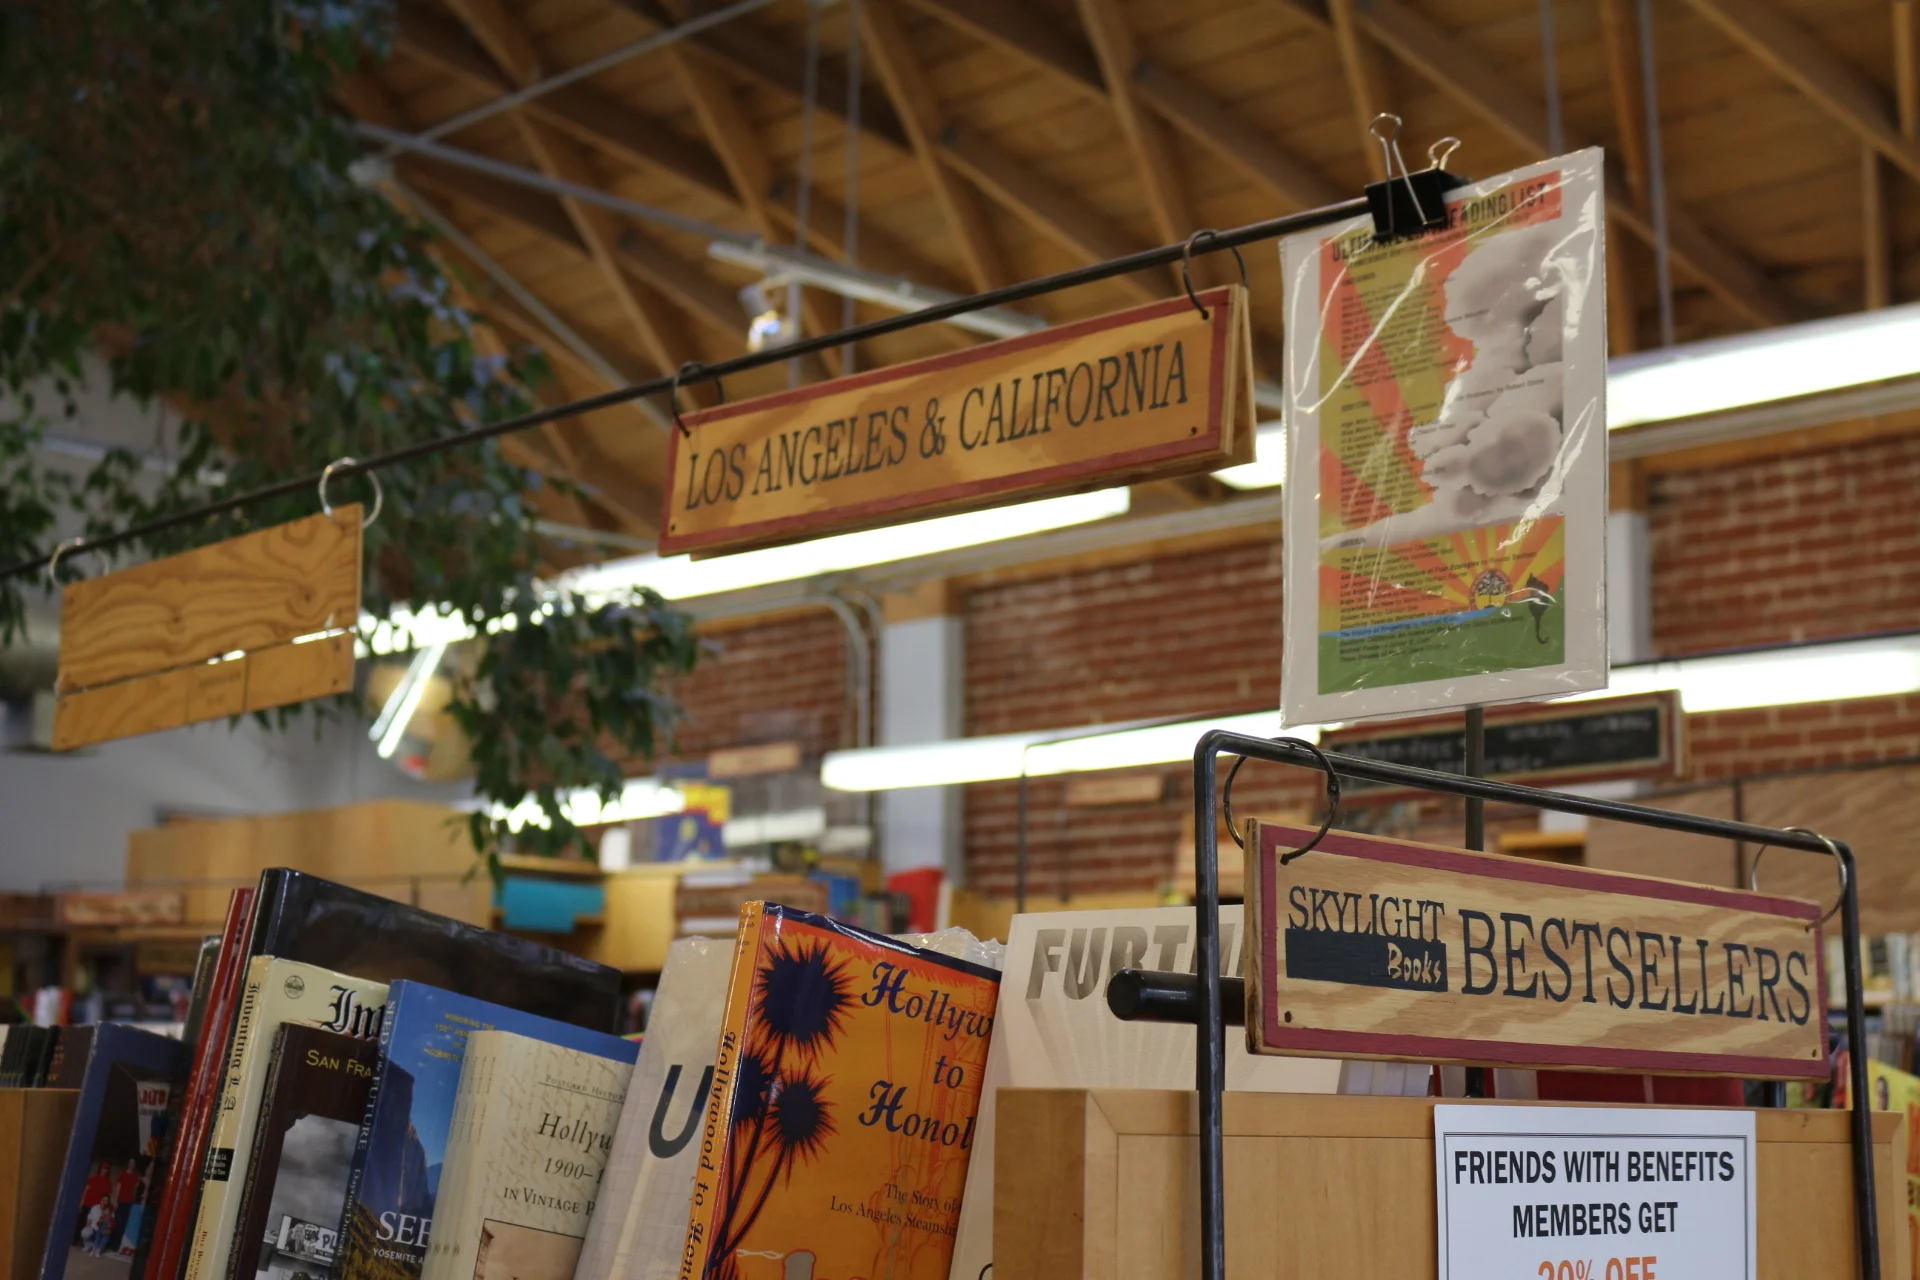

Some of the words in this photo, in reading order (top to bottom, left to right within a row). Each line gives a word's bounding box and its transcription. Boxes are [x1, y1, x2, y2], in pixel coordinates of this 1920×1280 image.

[686, 442, 746, 510] LOS
[751, 404, 908, 496] ANGELES
[919, 397, 946, 460] &
[958, 340, 1189, 452] CALIFORNIA
[1288, 885, 1445, 944] SKYLIGHT
[1458, 908, 1811, 1026] BESTSELLERS
[1386, 942, 1442, 985] Books
[379, 999, 396, 1046] SEED
[306, 1049, 340, 1071] SAN
[933, 1055, 965, 1089] to
[356, 1074, 381, 1151] FUTURE
[702, 1031, 737, 1171] Hollywood
[858, 1080, 976, 1150] Honol
[1454, 1150, 1556, 1184] FRIENDS
[1563, 1150, 1619, 1183] WITH
[1626, 1150, 1735, 1183] BENEFITS
[503, 1187, 519, 1201] IN
[523, 1186, 579, 1214] VINTAGE
[695, 1182, 709, 1207] to
[830, 1195, 853, 1213] Los
[856, 1201, 902, 1226] Angeles
[885, 1183, 907, 1202] The
[911, 1189, 940, 1210] Story
[1512, 1202, 1631, 1238] MEMBERS
[1638, 1201, 1678, 1233] GET
[373, 1247, 416, 1264] YOSEMITE
[1537, 1259, 1593, 1280] 20%
[1605, 1256, 1657, 1280] OFF
